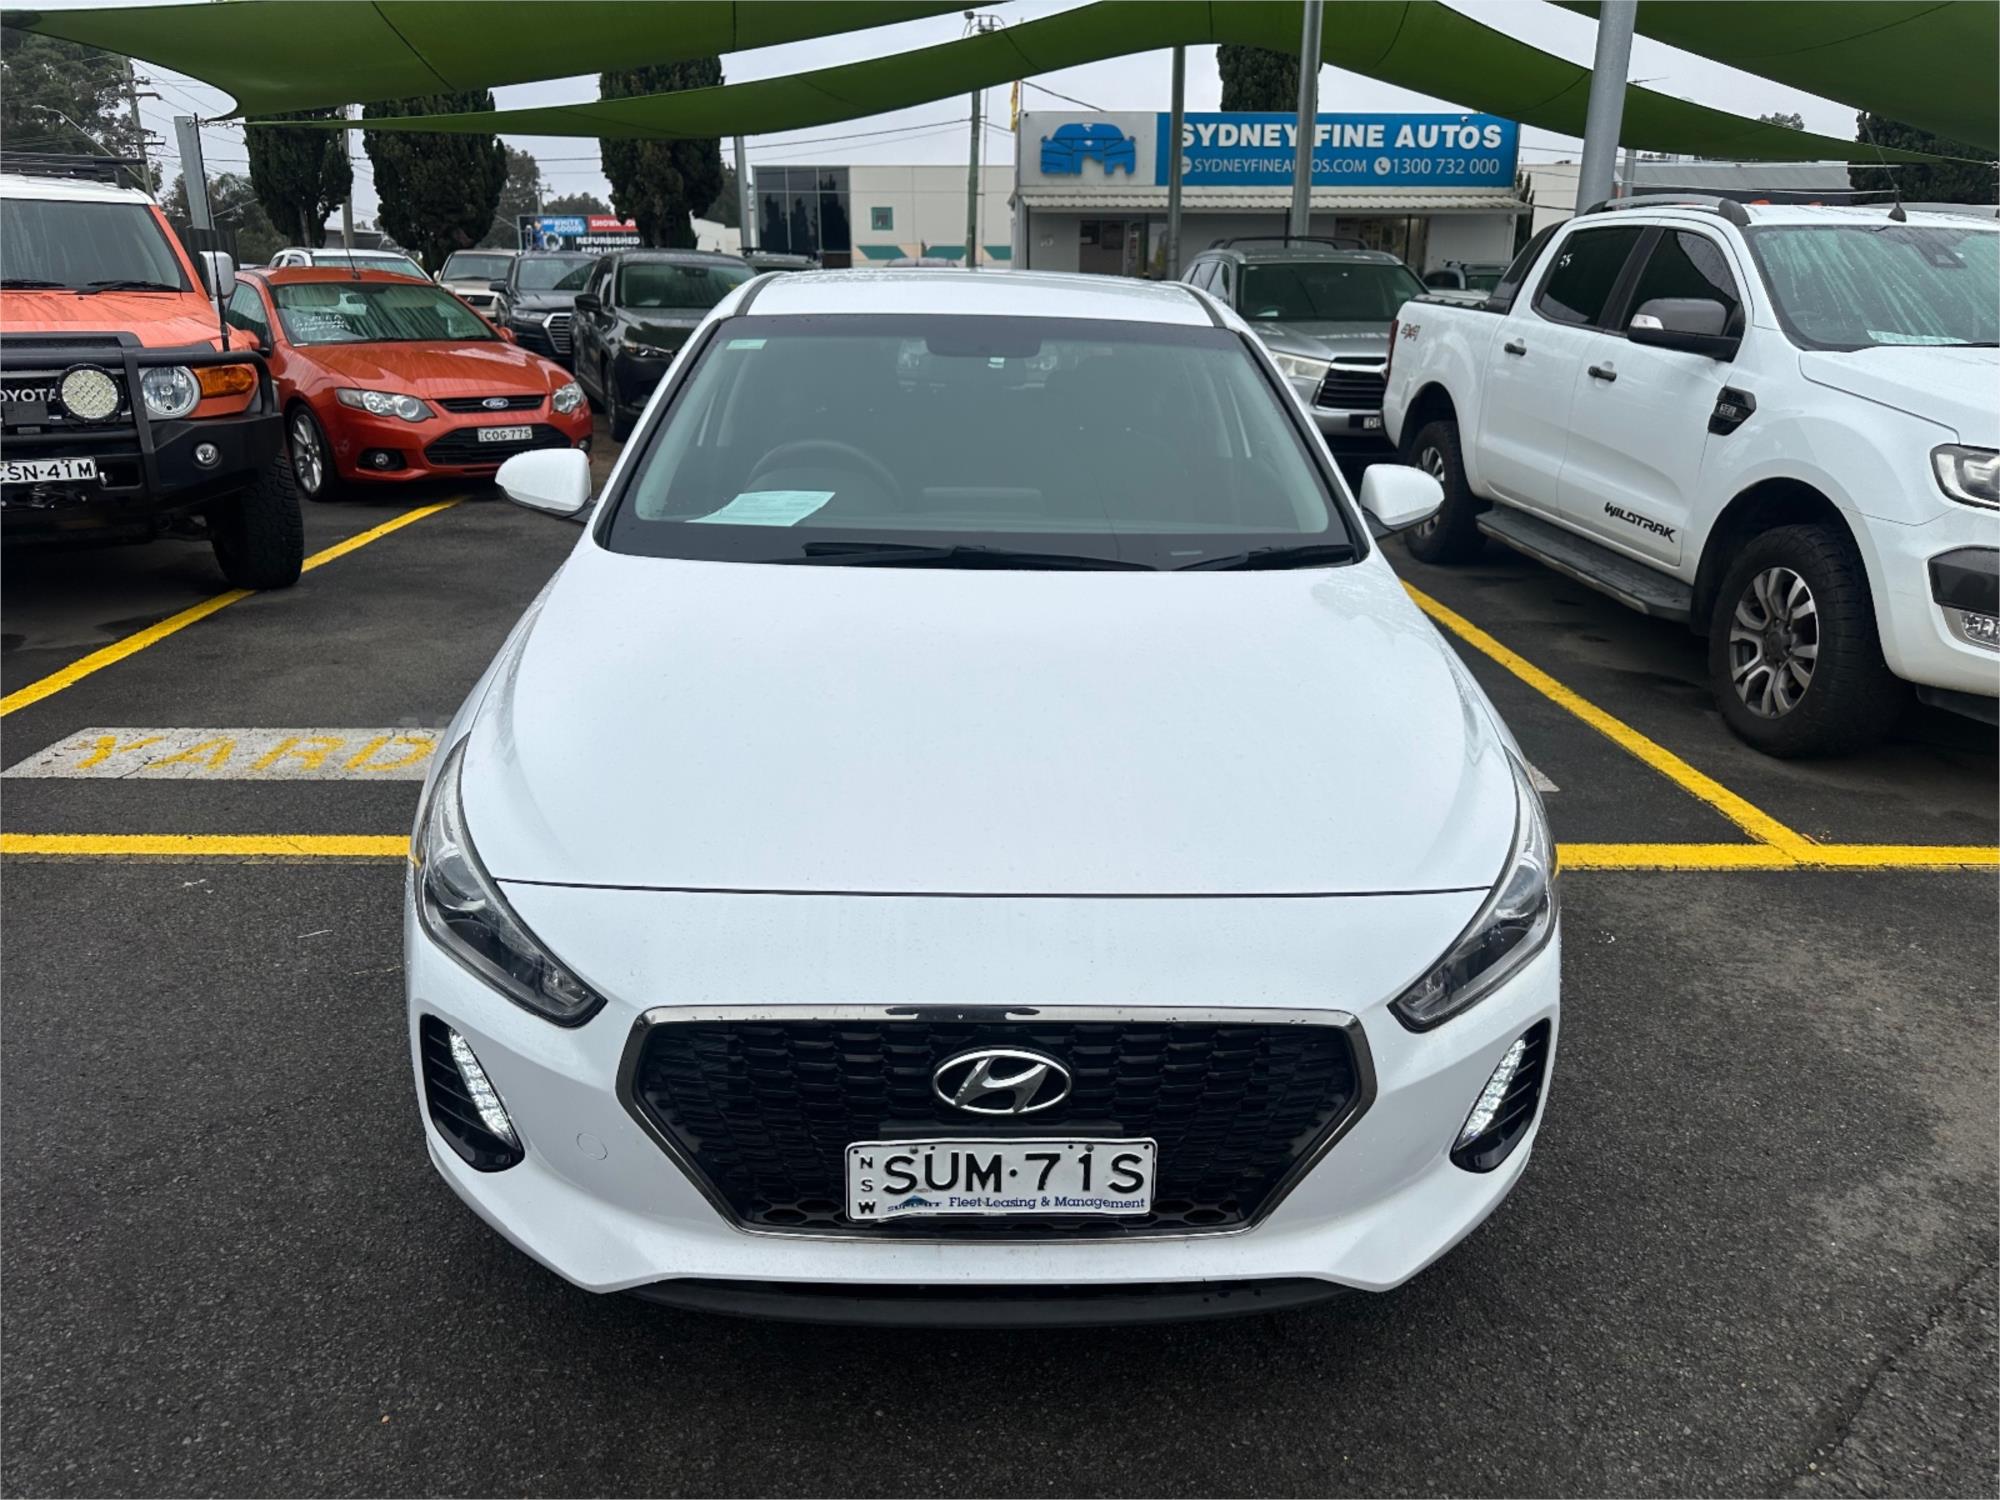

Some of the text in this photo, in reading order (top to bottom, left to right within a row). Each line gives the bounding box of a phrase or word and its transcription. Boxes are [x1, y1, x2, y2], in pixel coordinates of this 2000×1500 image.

[1182, 123, 1502, 149] SYDNEY FINE AUTOS
[1195, 158, 1367, 173] SYDNEYFINEAOS.COM
[1393, 158, 1500, 174] 1300 732 000
[576, 236, 640, 245] REFURBISHED
[1604, 501, 1676, 543] WILDTRAK
[66, 734, 436, 771] YARD
[949, 1197, 982, 1208] Fleet
[985, 1197, 1036, 1210] Leasing
[1041, 1197, 1050, 1208] &
[1054, 1197, 1145, 1210] Management
